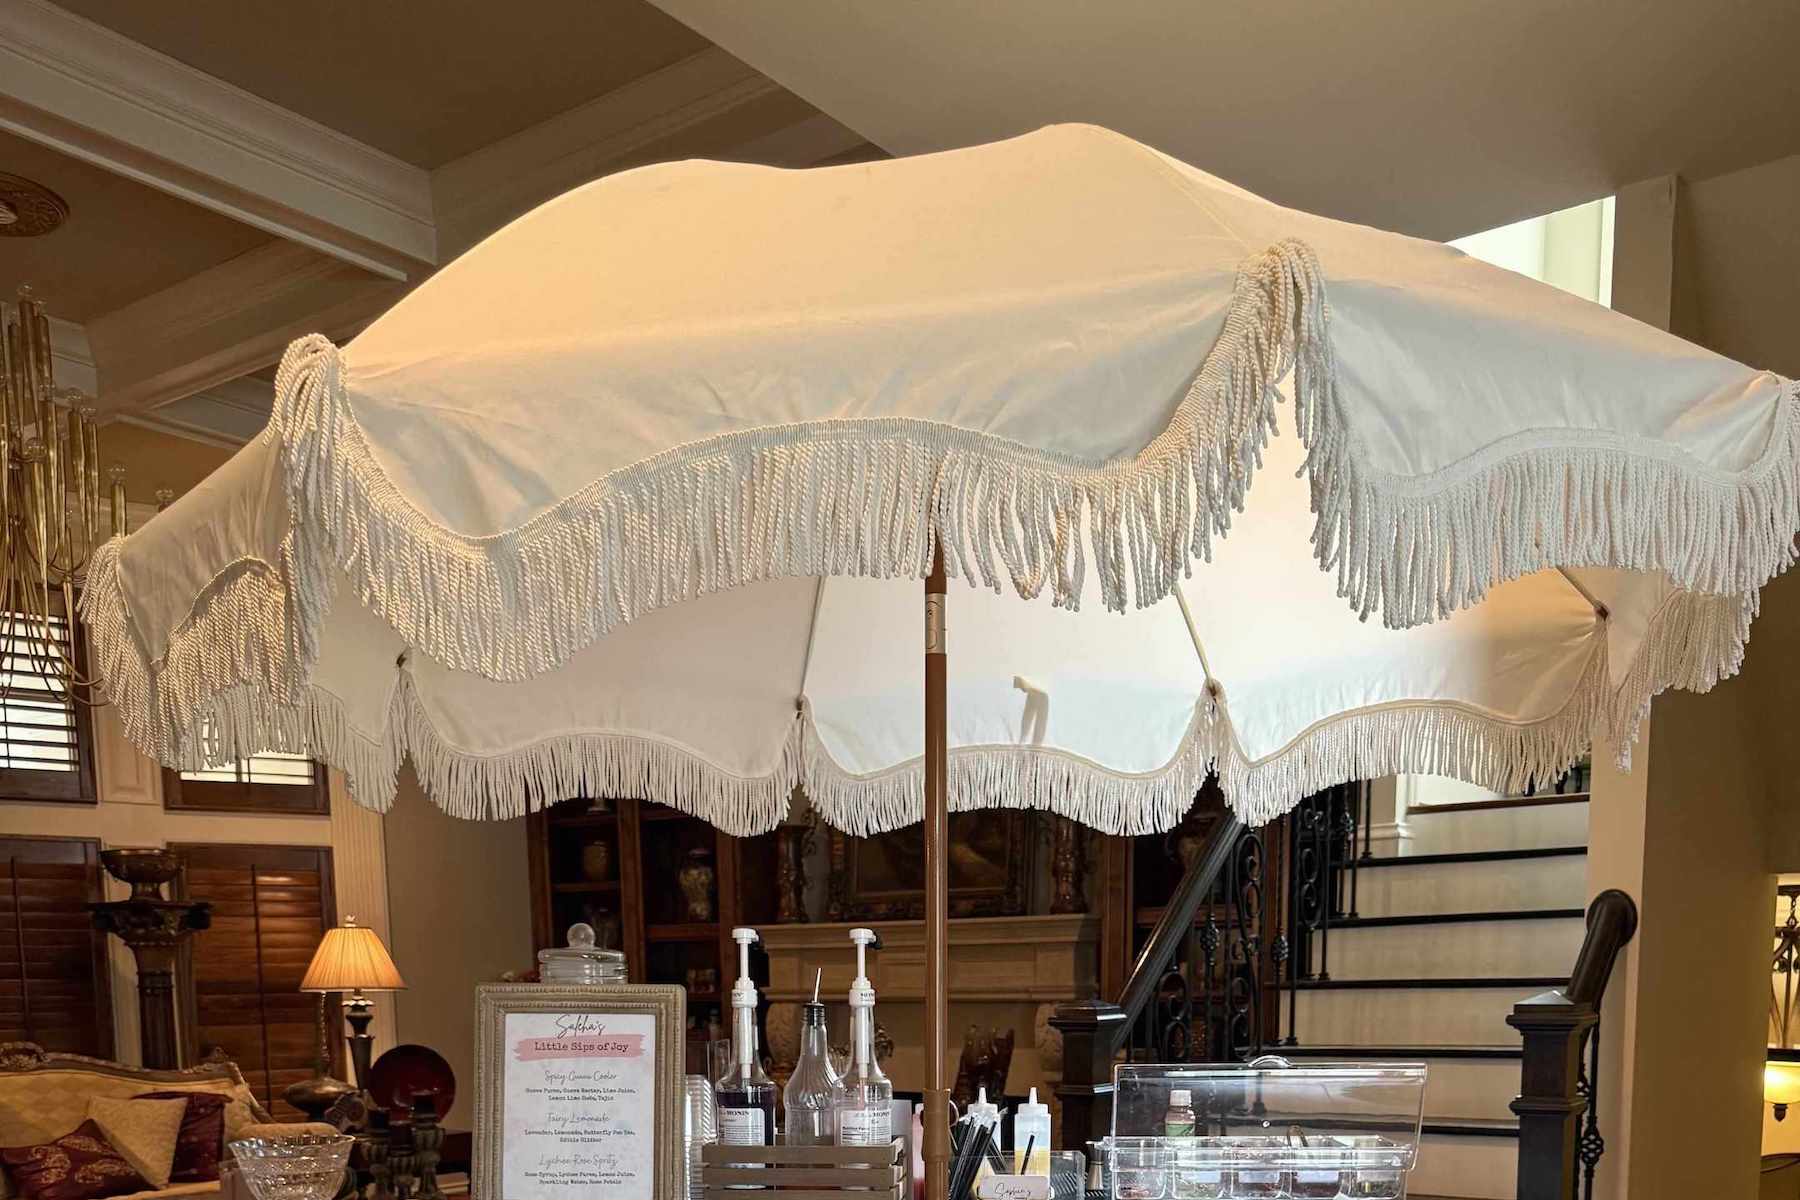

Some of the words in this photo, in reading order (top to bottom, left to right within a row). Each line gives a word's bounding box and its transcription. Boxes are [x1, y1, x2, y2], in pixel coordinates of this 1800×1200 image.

[555, 1014, 606, 1039] Saleha's
[534, 1042, 568, 1051] Little
[571, 1042, 594, 1052] Sips
[597, 1042, 610, 1051] of
[611, 1042, 629, 1053] Joy
